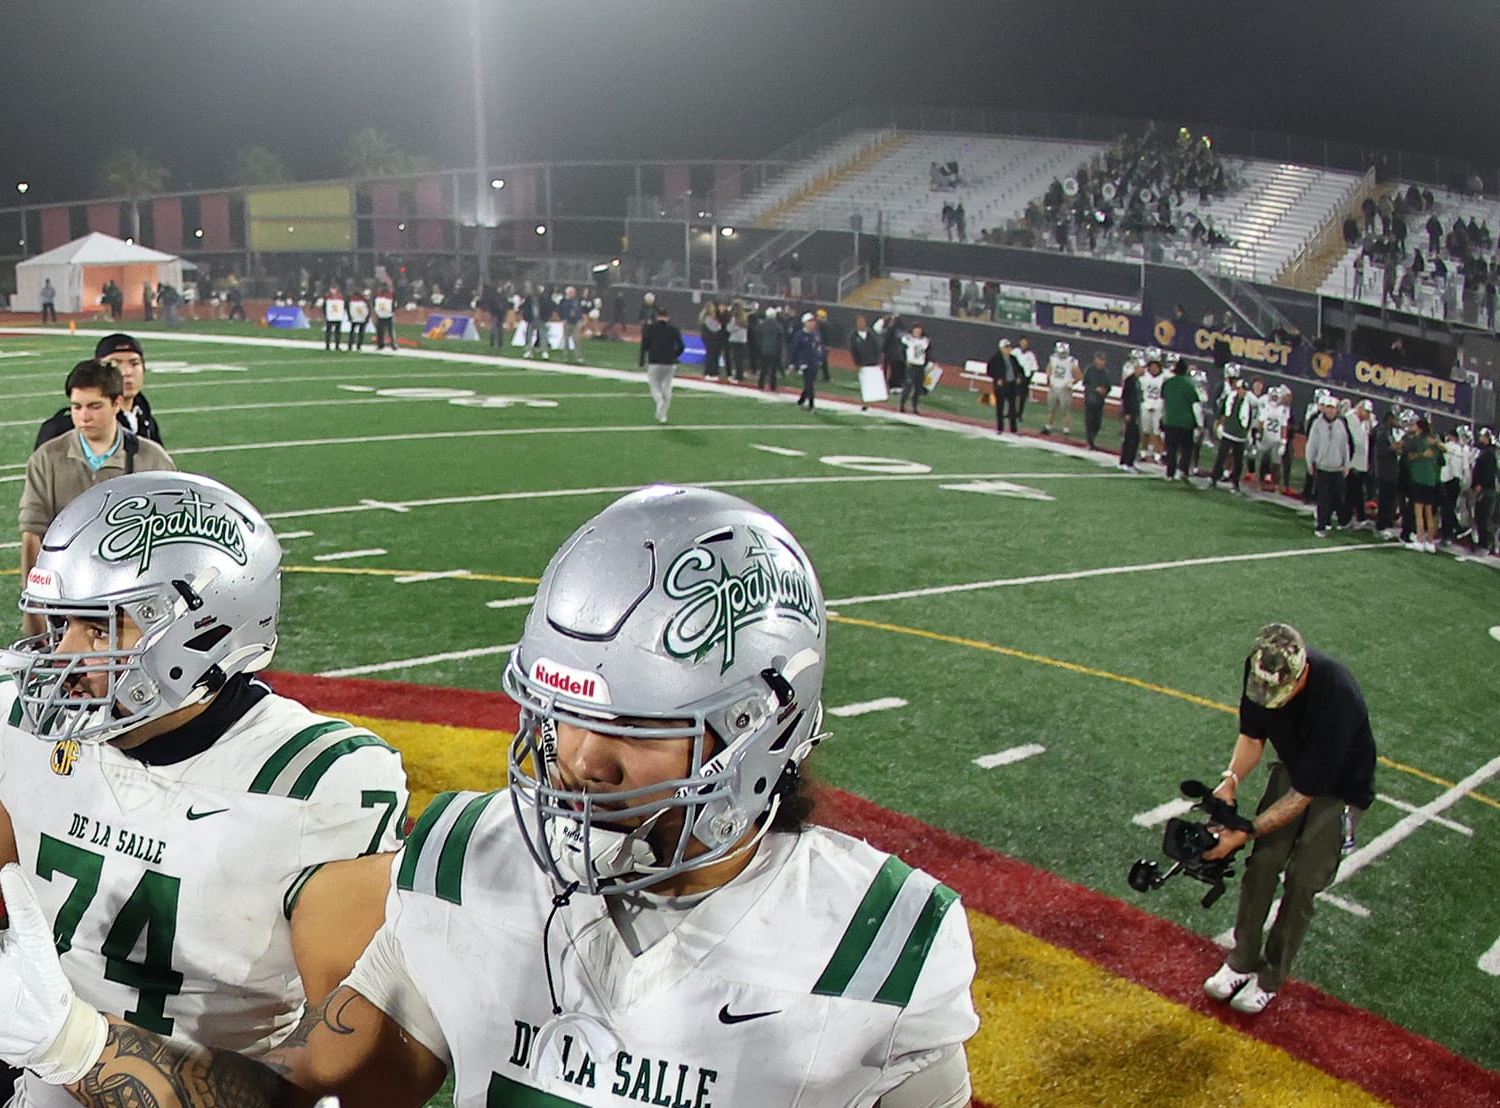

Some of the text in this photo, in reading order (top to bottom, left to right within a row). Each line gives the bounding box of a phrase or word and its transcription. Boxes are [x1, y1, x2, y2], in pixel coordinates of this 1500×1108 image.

[1053, 306, 1130, 335] BELONG
[1355, 360, 1457, 404] COMPETE
[99, 487, 248, 578] Spartans
[663, 525, 822, 676] Spartans
[535, 664, 596, 698] Riddell
[68, 813, 168, 865] DE LA SALLE
[35, 832, 184, 1037] 74
